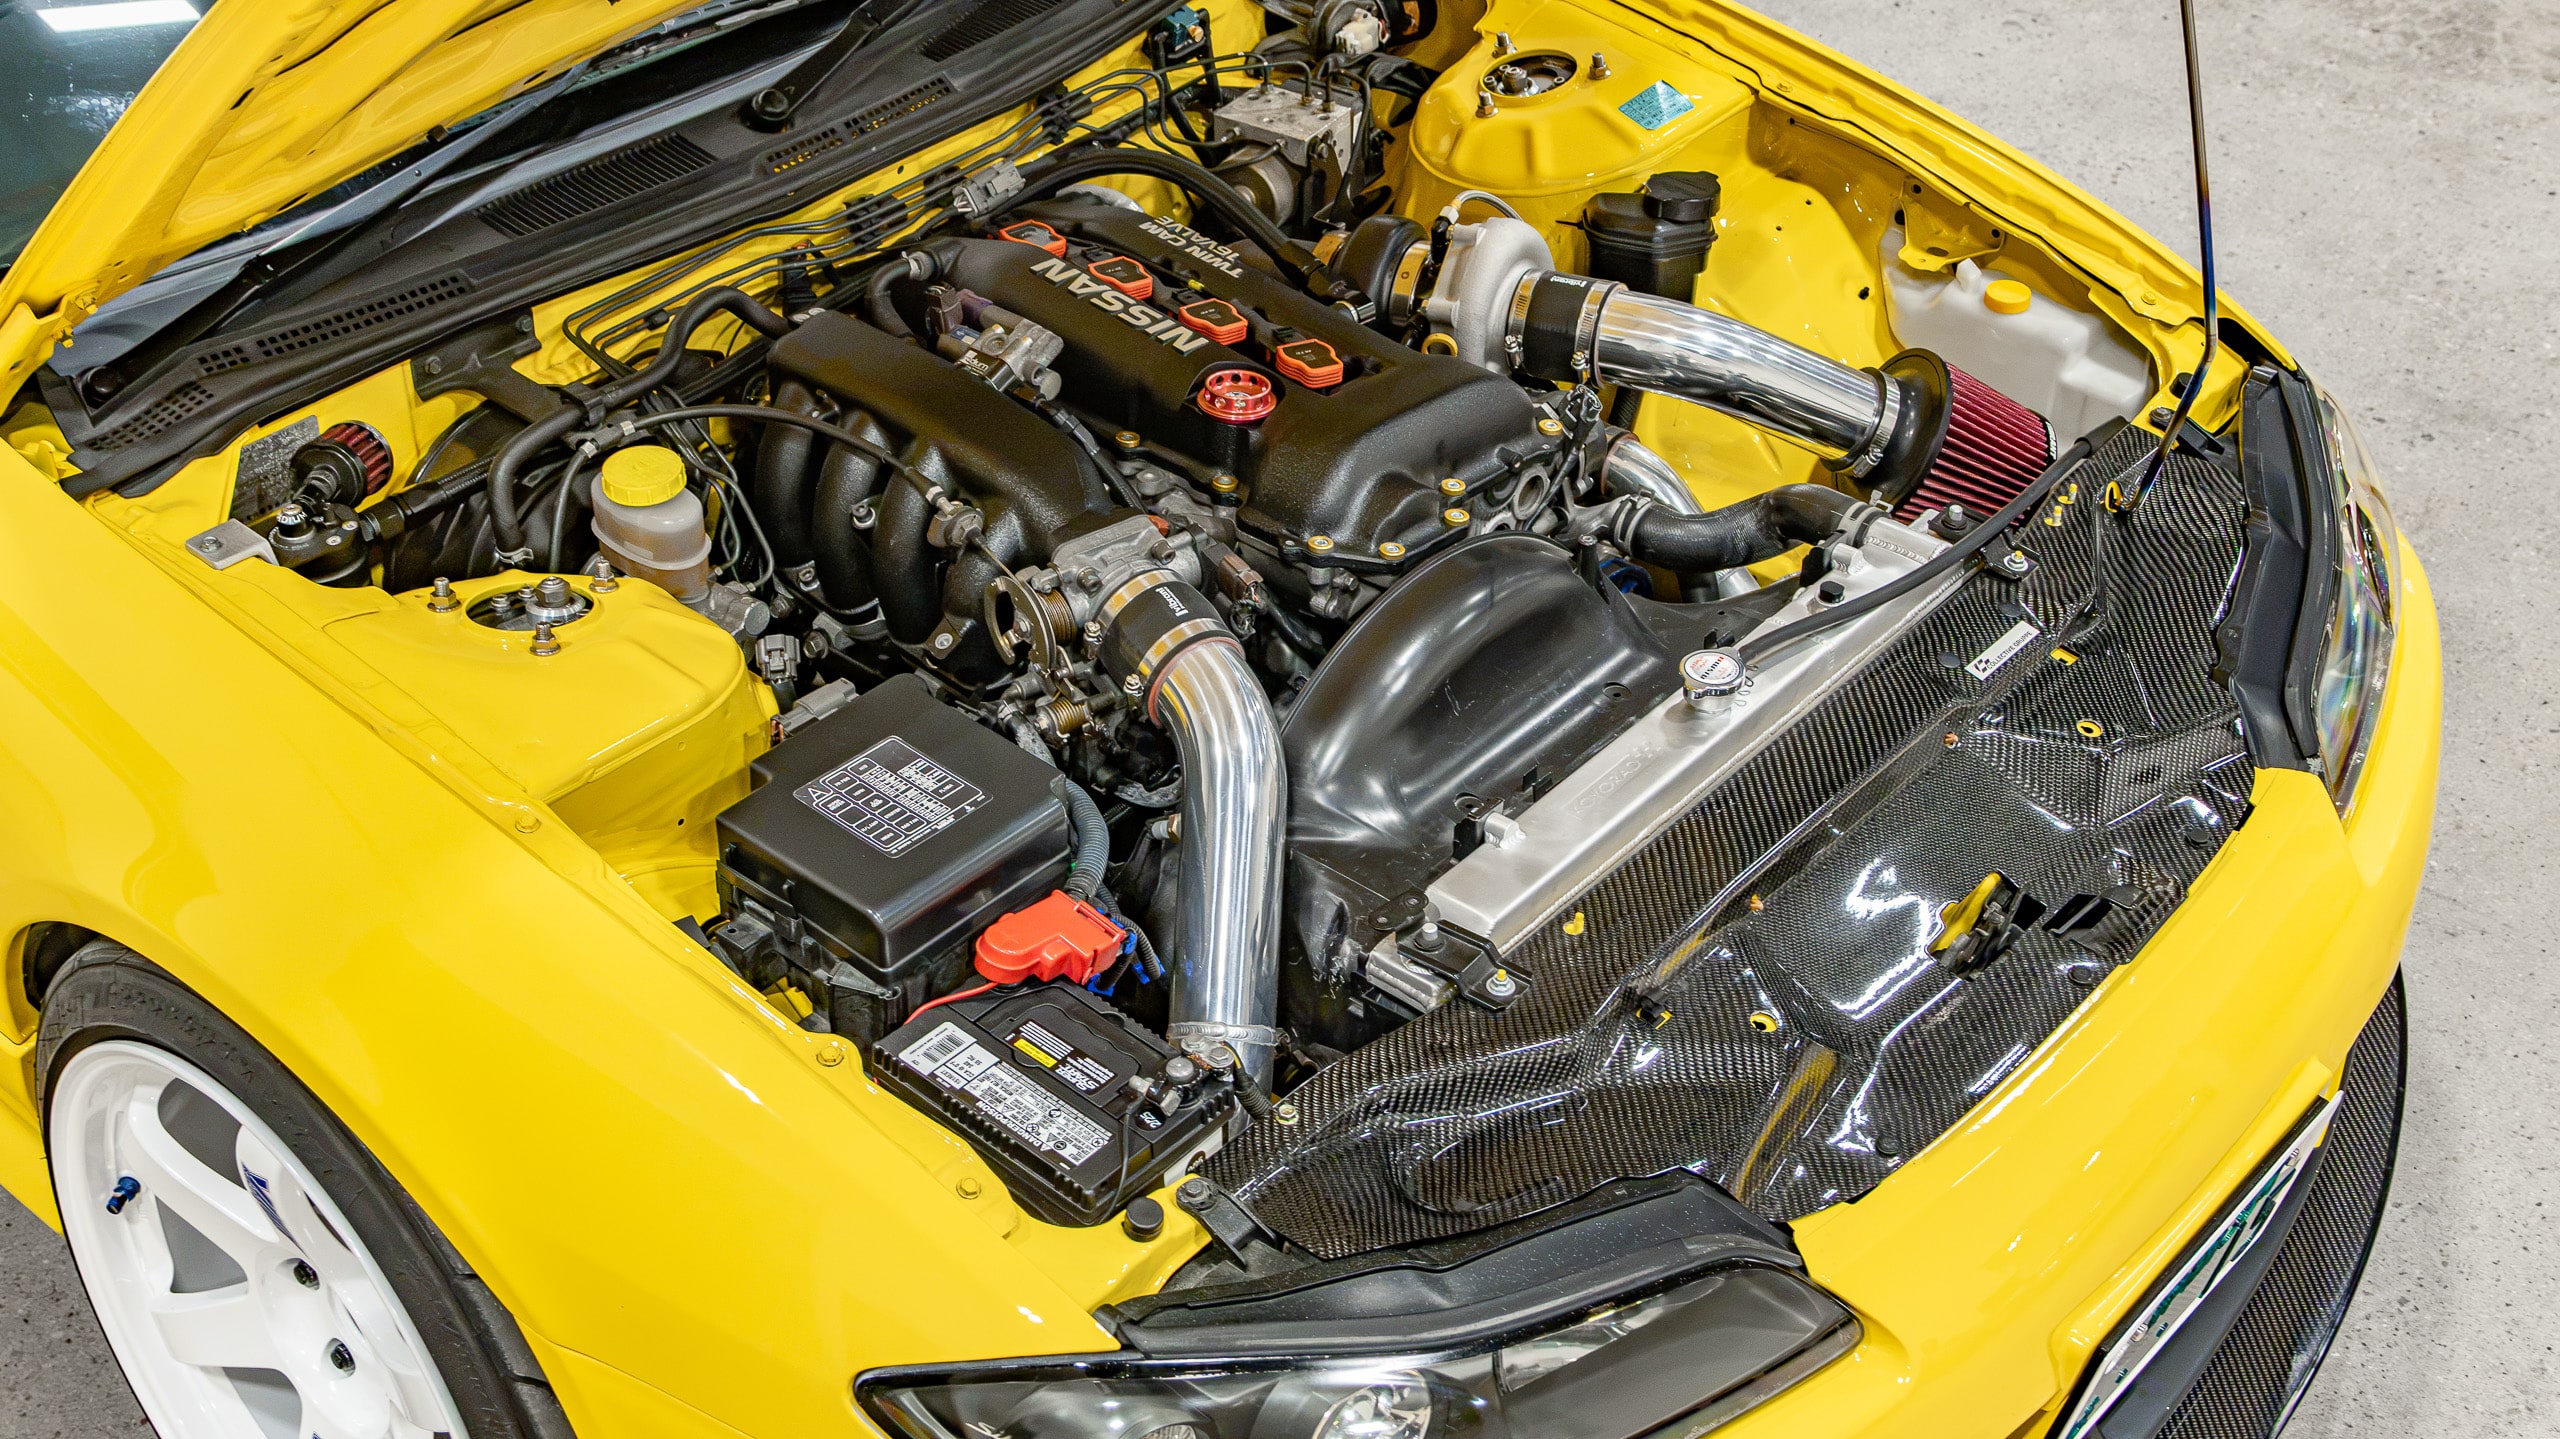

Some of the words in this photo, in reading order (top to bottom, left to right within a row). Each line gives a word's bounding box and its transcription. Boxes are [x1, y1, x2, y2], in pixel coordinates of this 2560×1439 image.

[1138, 219, 1187, 245] CAM
[1154, 215, 1241, 264] 16VALVE
[1185, 244, 1243, 279] TWIN
[1029, 257, 1210, 357] NISSAN
[276, 511, 308, 526] ADIUM
[1155, 586, 1184, 615] vibrant
[1986, 645, 2015, 670] COLLECTIVE
[2013, 630, 2033, 647] GRUPPE
[1700, 656, 1725, 680] nismo
[963, 1069, 975, 1077] CCA
[1054, 1068, 1088, 1091] SUPER
[1142, 1110, 1163, 1128] 2/25
